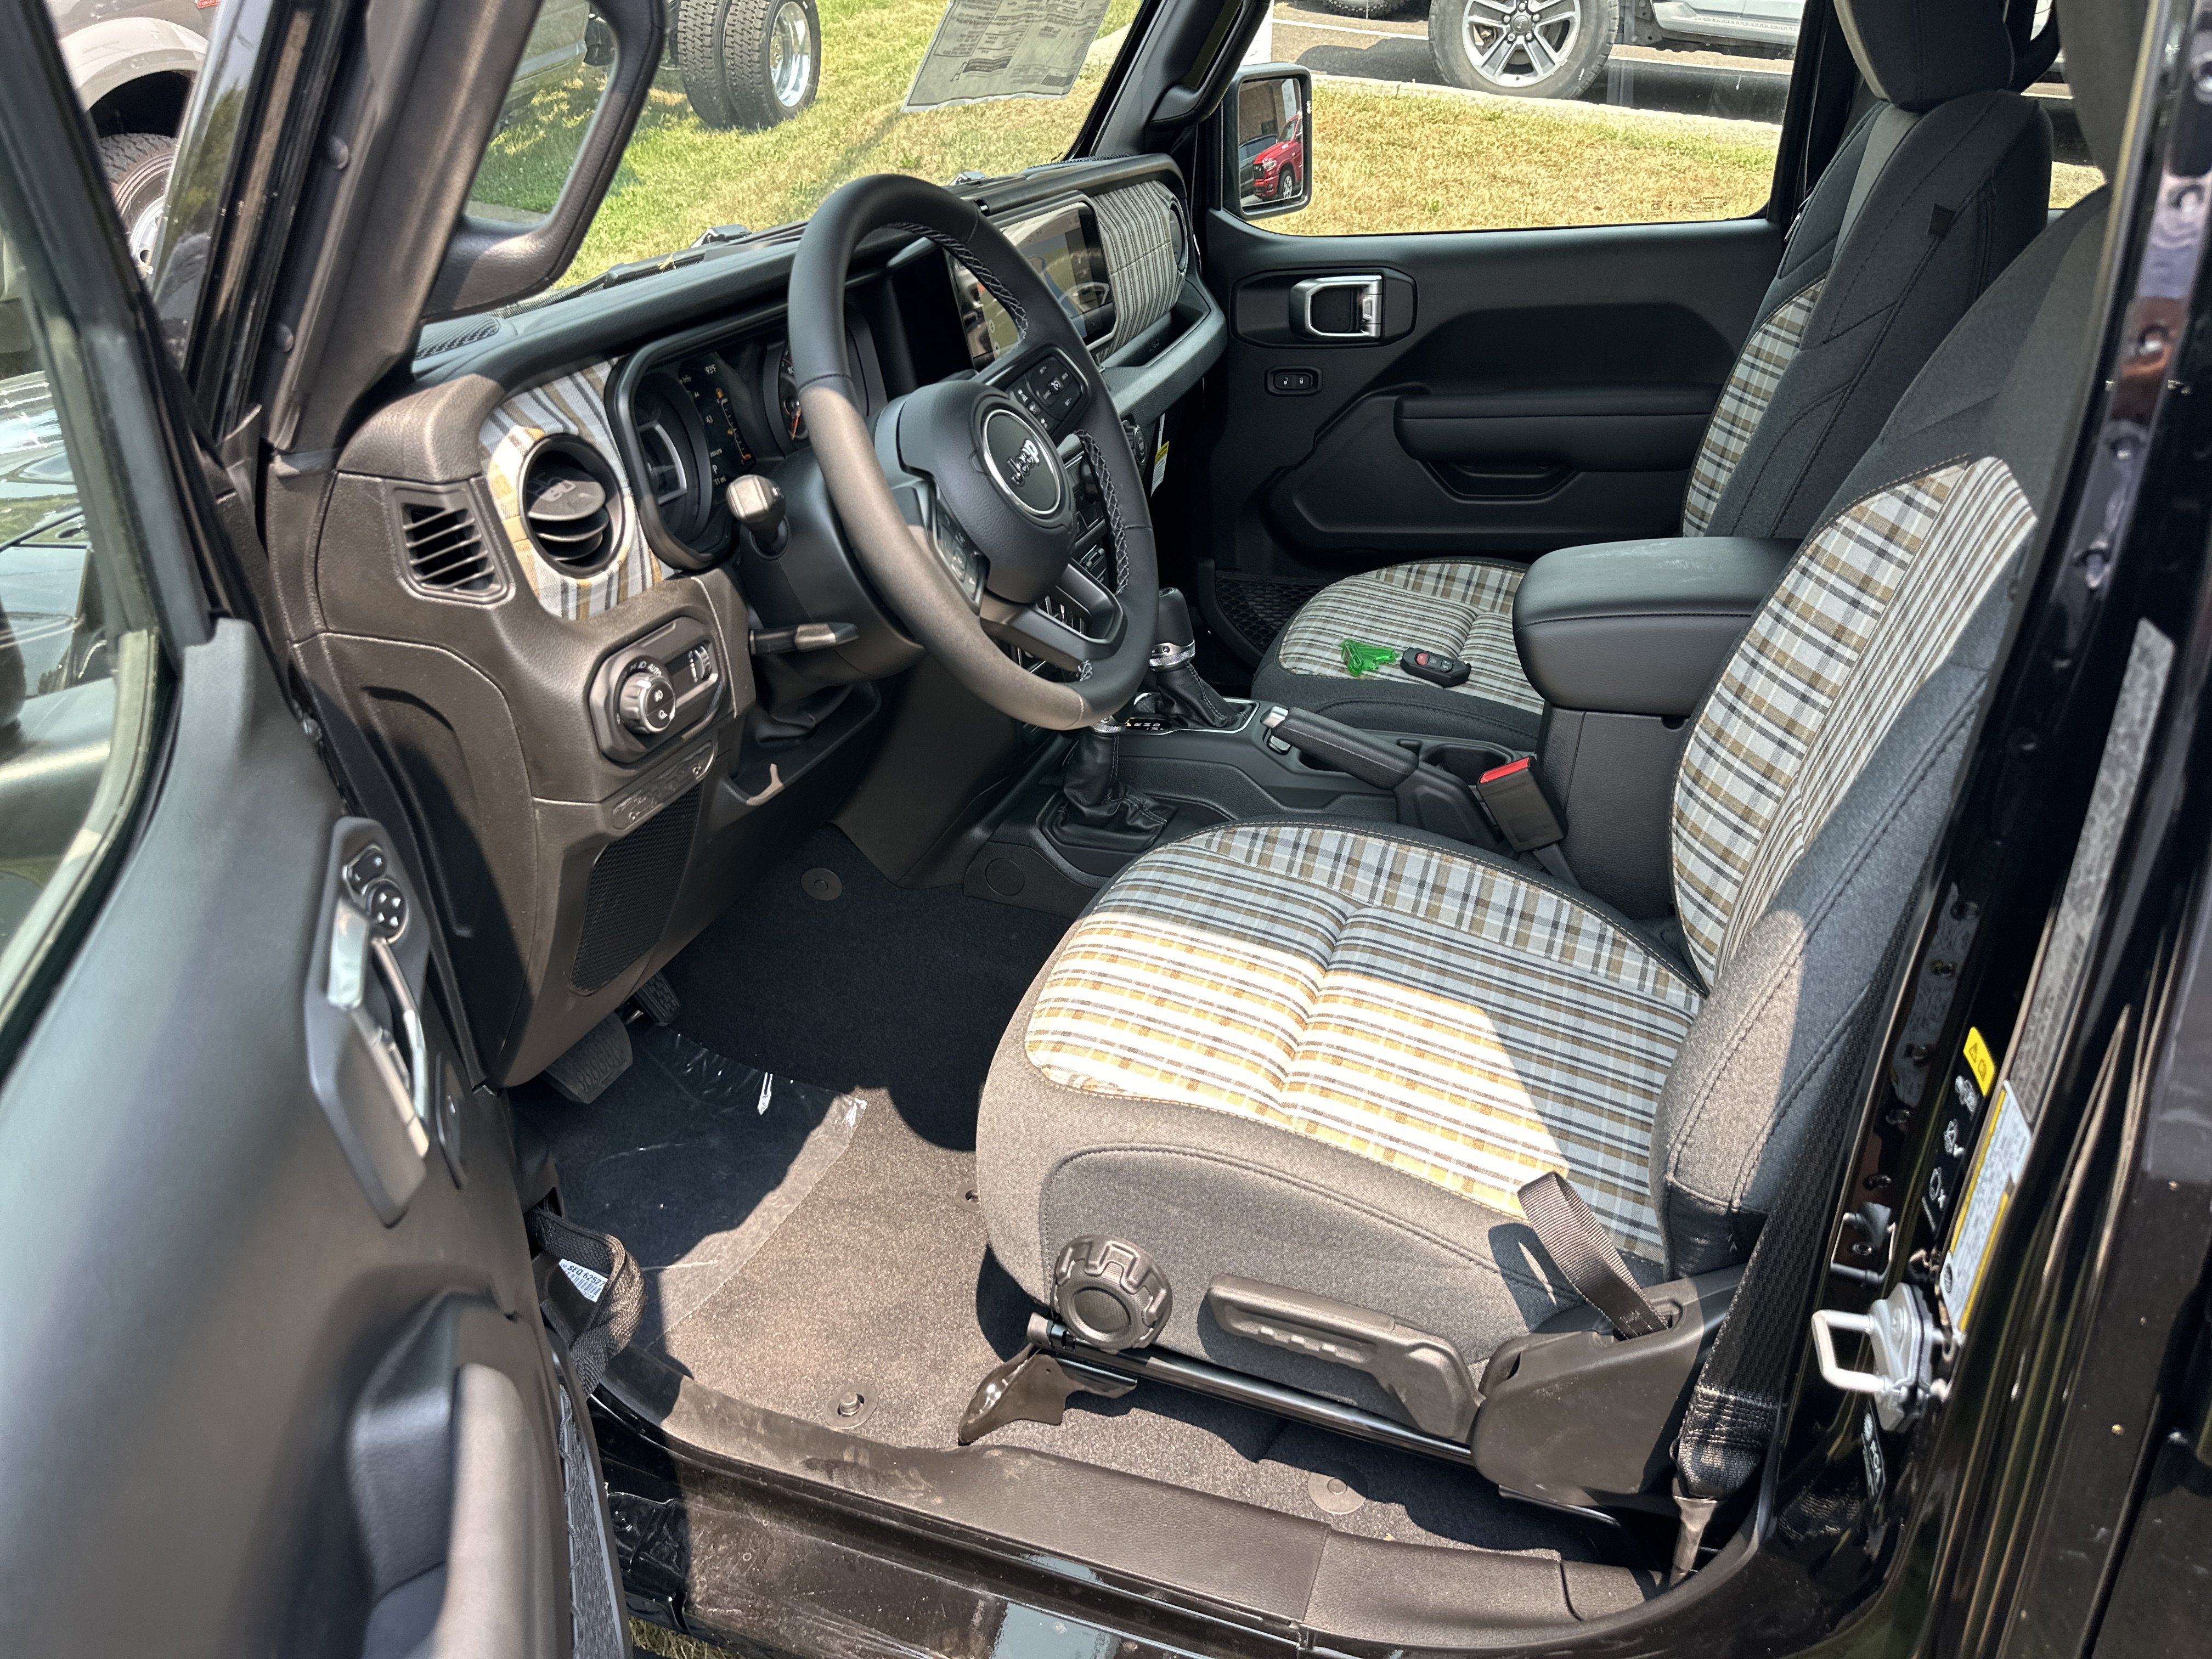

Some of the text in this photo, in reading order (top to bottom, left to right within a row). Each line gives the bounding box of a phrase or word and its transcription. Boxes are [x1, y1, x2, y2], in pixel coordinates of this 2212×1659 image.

[713, 465, 718, 474] P
[1007, 439, 1040, 486] Jeep
[648, 663, 662, 676] AUTO
[567, 1266, 583, 1276] SEQ
[583, 1272, 606, 1286] 62527
